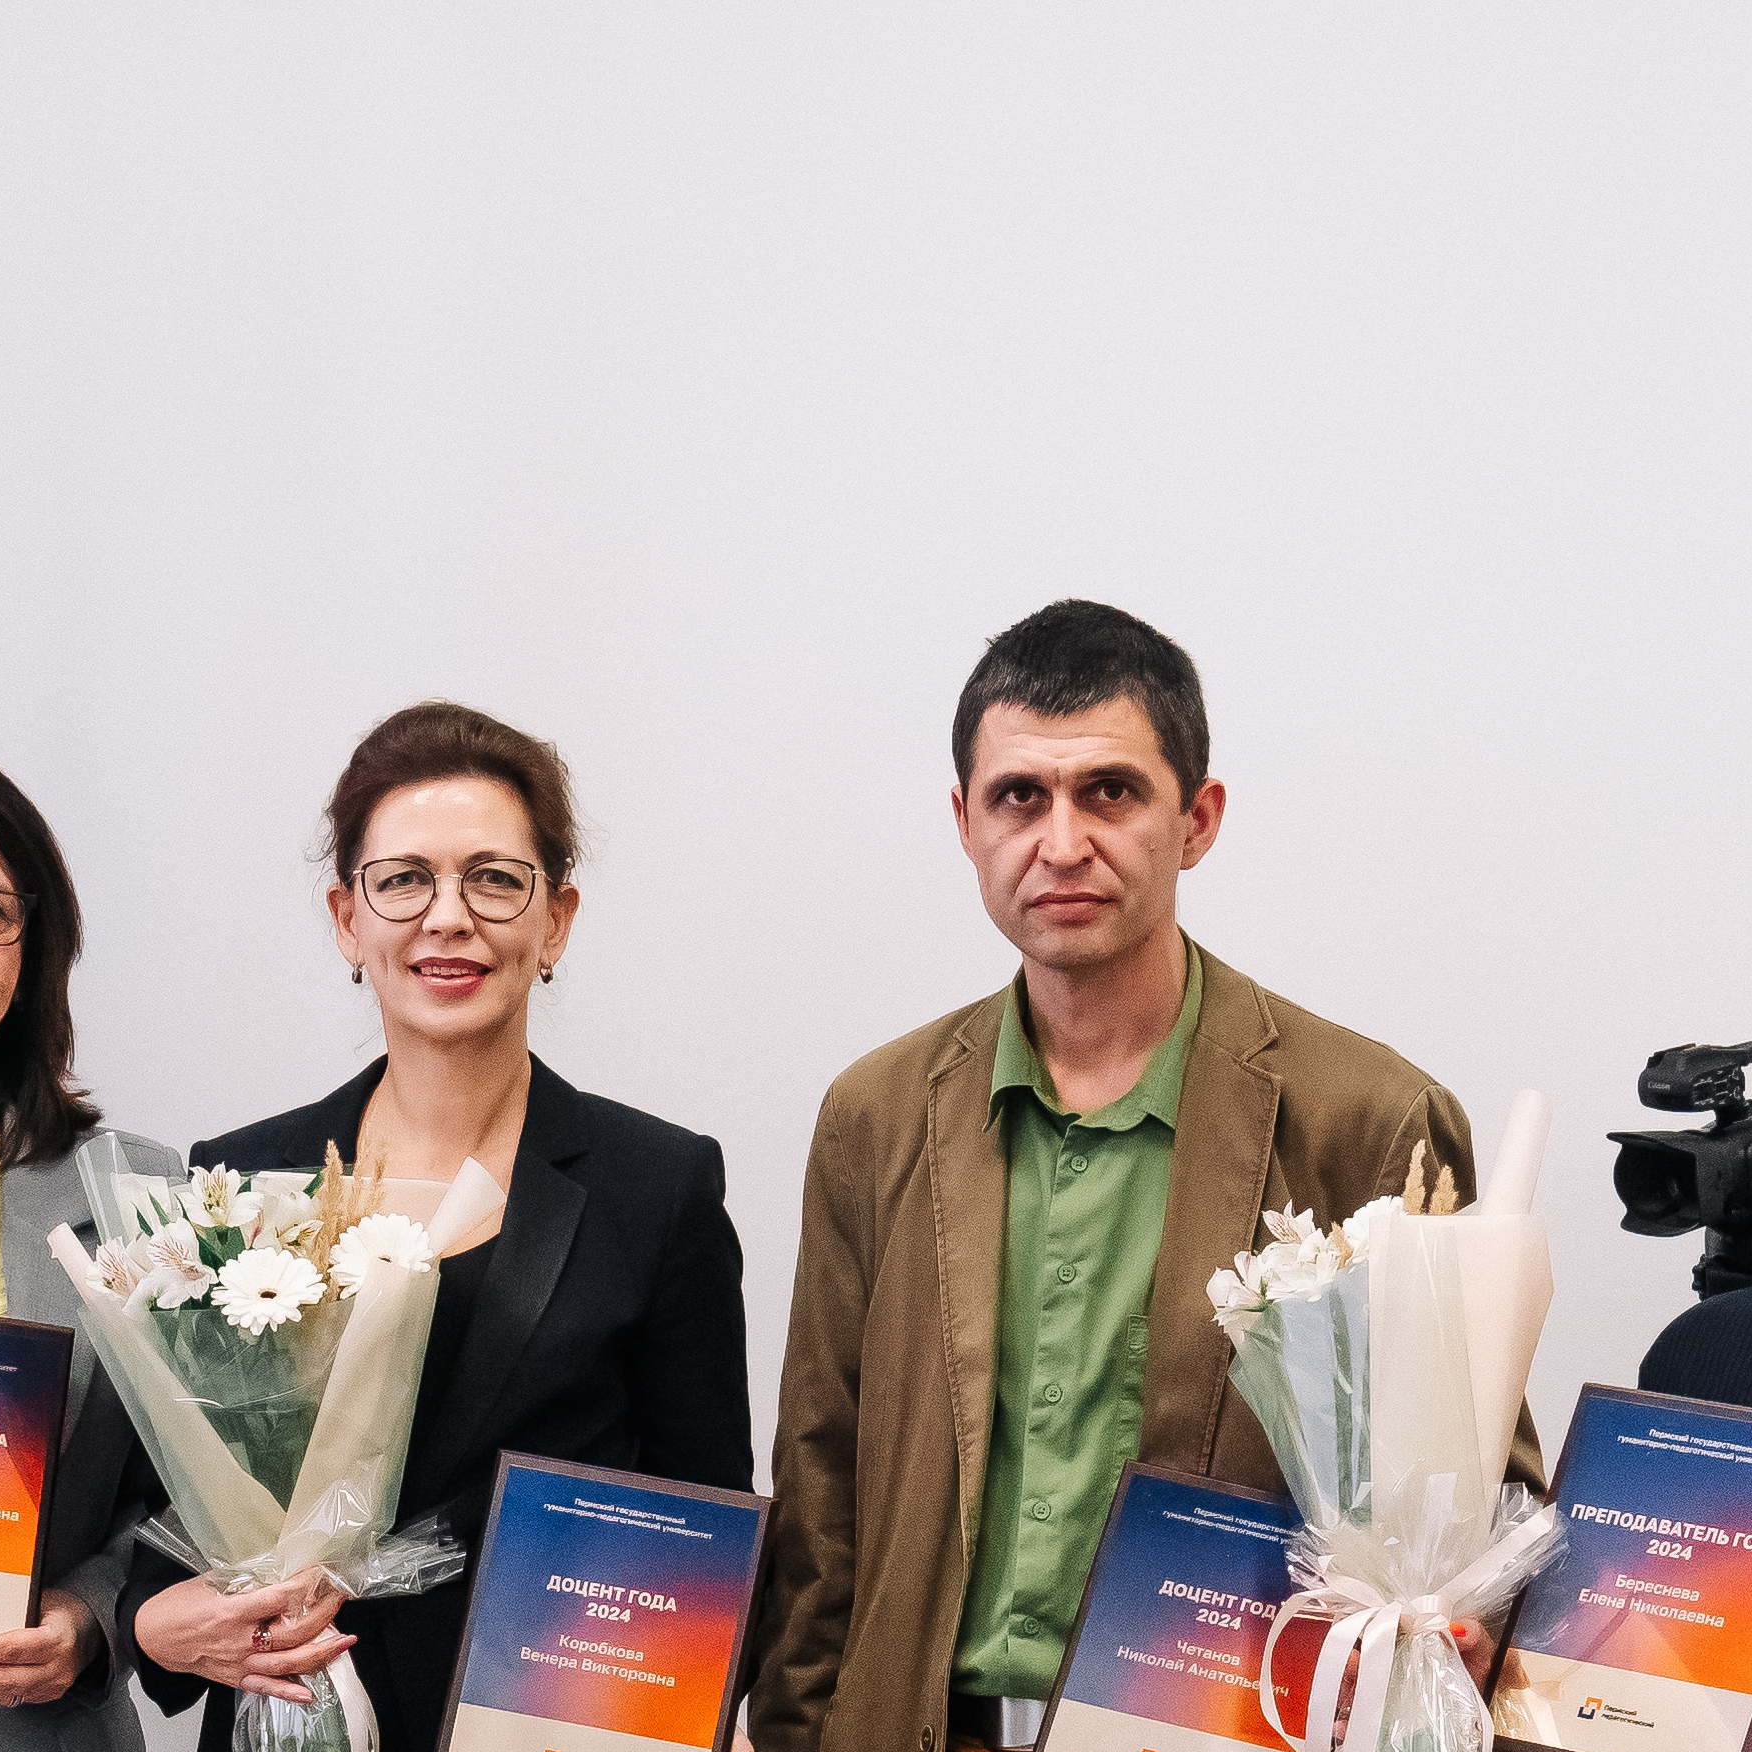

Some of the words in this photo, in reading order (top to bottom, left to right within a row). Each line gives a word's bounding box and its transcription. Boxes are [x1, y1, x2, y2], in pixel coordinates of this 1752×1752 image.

[1570, 1502, 1729, 1546] ПРЕПОДАВАТЕЛЬ
[1646, 1538, 1693, 1562] 2024
[546, 1574, 626, 1603] ДОЦЕНТ
[627, 1588, 678, 1613] ГОДА
[1158, 1579, 1239, 1609] ДОЦЕНТ
[1239, 1597, 1285, 1621] ГОД
[1614, 1573, 1700, 1602] Береснева
[585, 1602, 632, 1624] 2024
[1195, 1608, 1243, 1631] 2024
[1578, 1587, 1626, 1610] Елена
[1629, 1598, 1725, 1629] Николаевна
[558, 1634, 645, 1662] Коробкова
[1176, 1639, 1241, 1667] Четанов
[519, 1646, 578, 1671] Венера
[580, 1658, 676, 1688] Викторовна
[1116, 1645, 1185, 1672] Николай
[1187, 1662, 1290, 1697] Анатольеич
